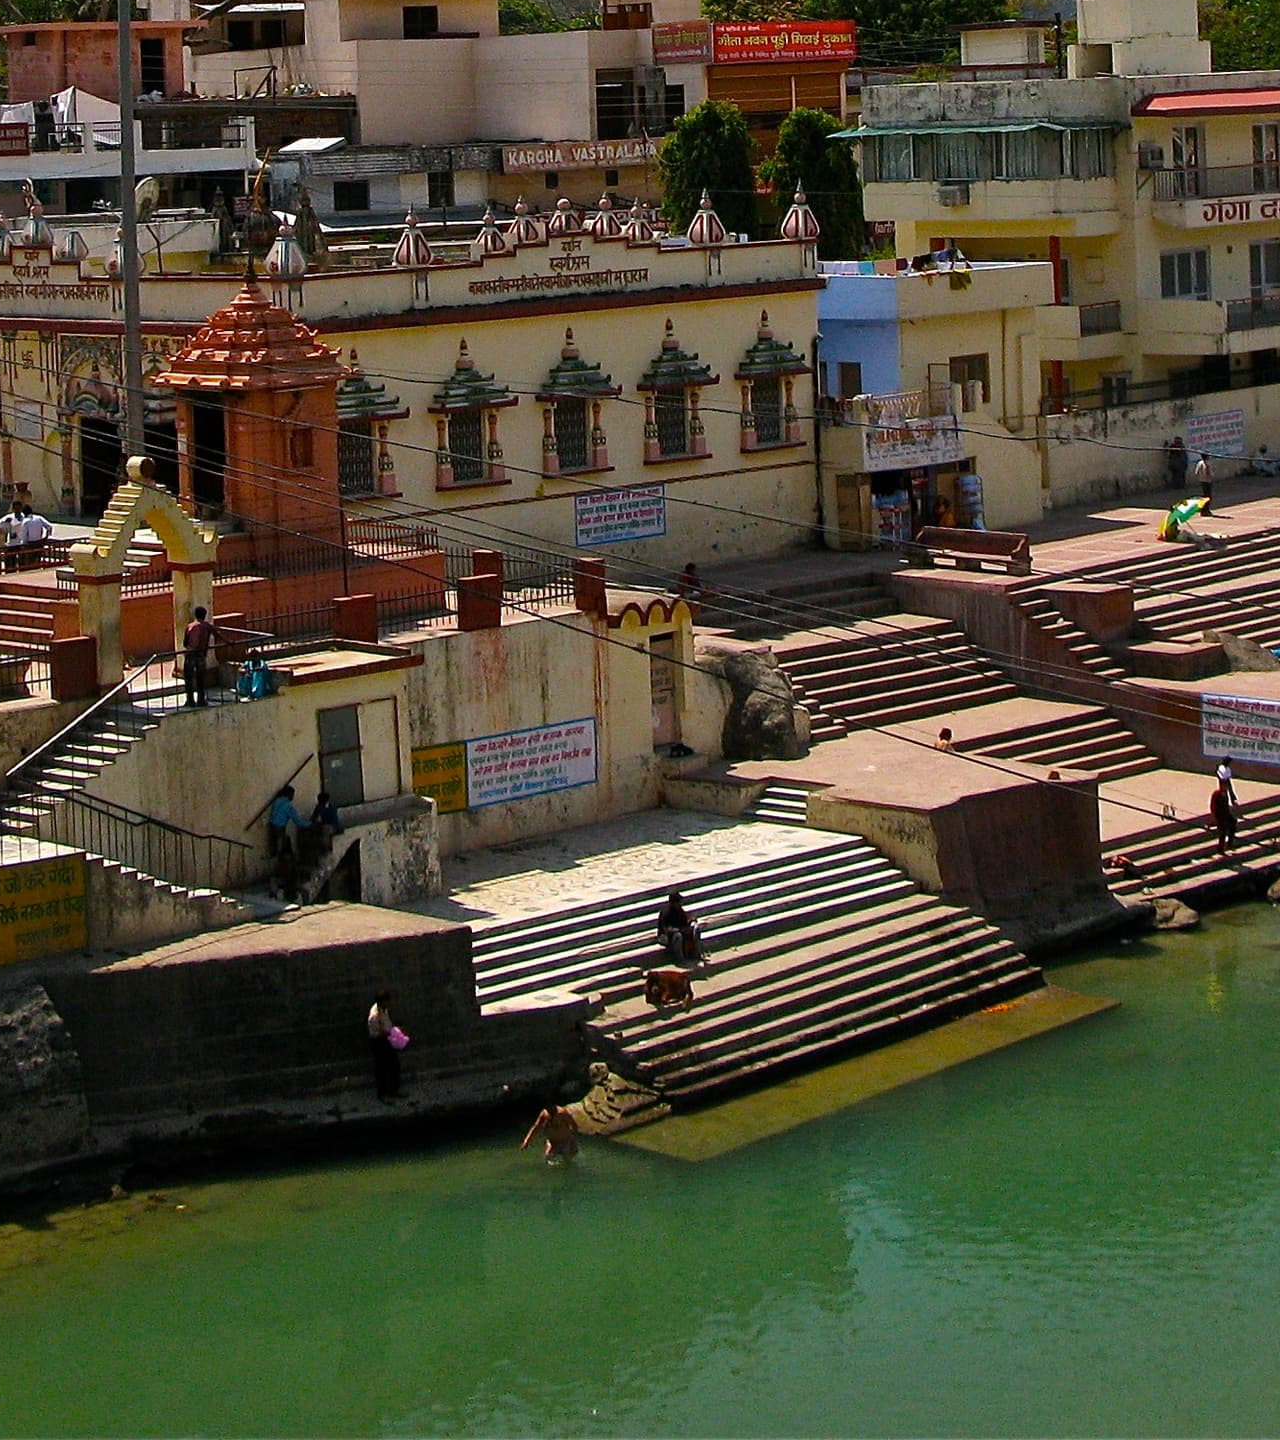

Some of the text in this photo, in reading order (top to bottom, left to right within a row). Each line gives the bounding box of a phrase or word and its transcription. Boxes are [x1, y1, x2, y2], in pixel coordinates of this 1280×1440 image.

[718, 32, 741, 46] गीता
[744, 35, 768, 46] भवन
[791, 31, 819, 46] मिठाई
[823, 33, 853, 48] दुकान
[508, 148, 563, 166] KARGHA
[1203, 199, 1251, 223] गंगा
